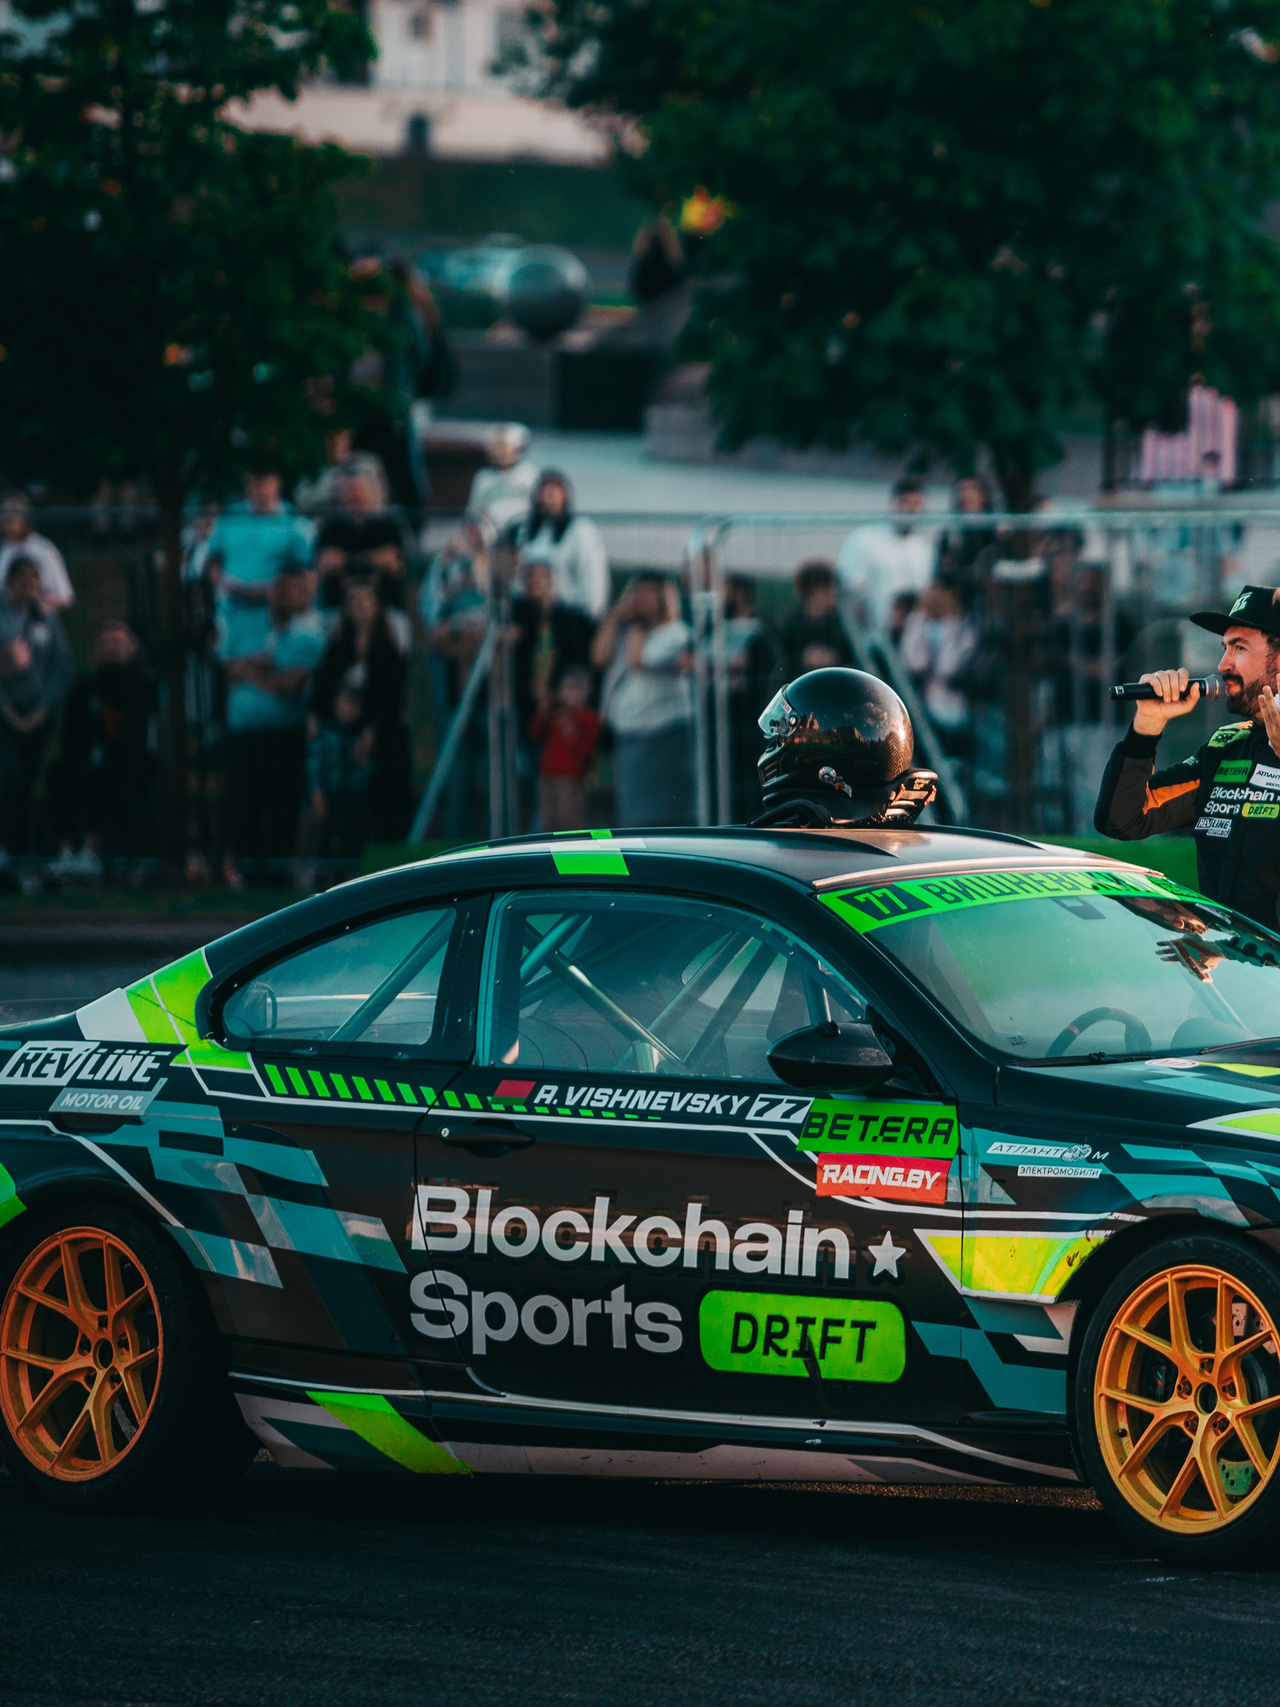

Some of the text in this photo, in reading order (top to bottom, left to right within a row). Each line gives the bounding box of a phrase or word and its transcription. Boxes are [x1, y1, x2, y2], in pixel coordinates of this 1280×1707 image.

[1210, 786, 1275, 801] Blockchain
[1248, 806, 1276, 815] DRIFT
[854, 887, 908, 915] 77
[60, 1092, 145, 1111] MOTOR OIL
[753, 1096, 808, 1121] 77
[991, 1144, 1064, 1157] АТЛАНТ
[822, 1164, 941, 1190] RACING.BY
[1019, 1165, 1100, 1177] ЭЛЕКТРОМОБИЛИ
[410, 1185, 851, 1280] Blockchain
[409, 1271, 878, 1364] Sports DRIFT
